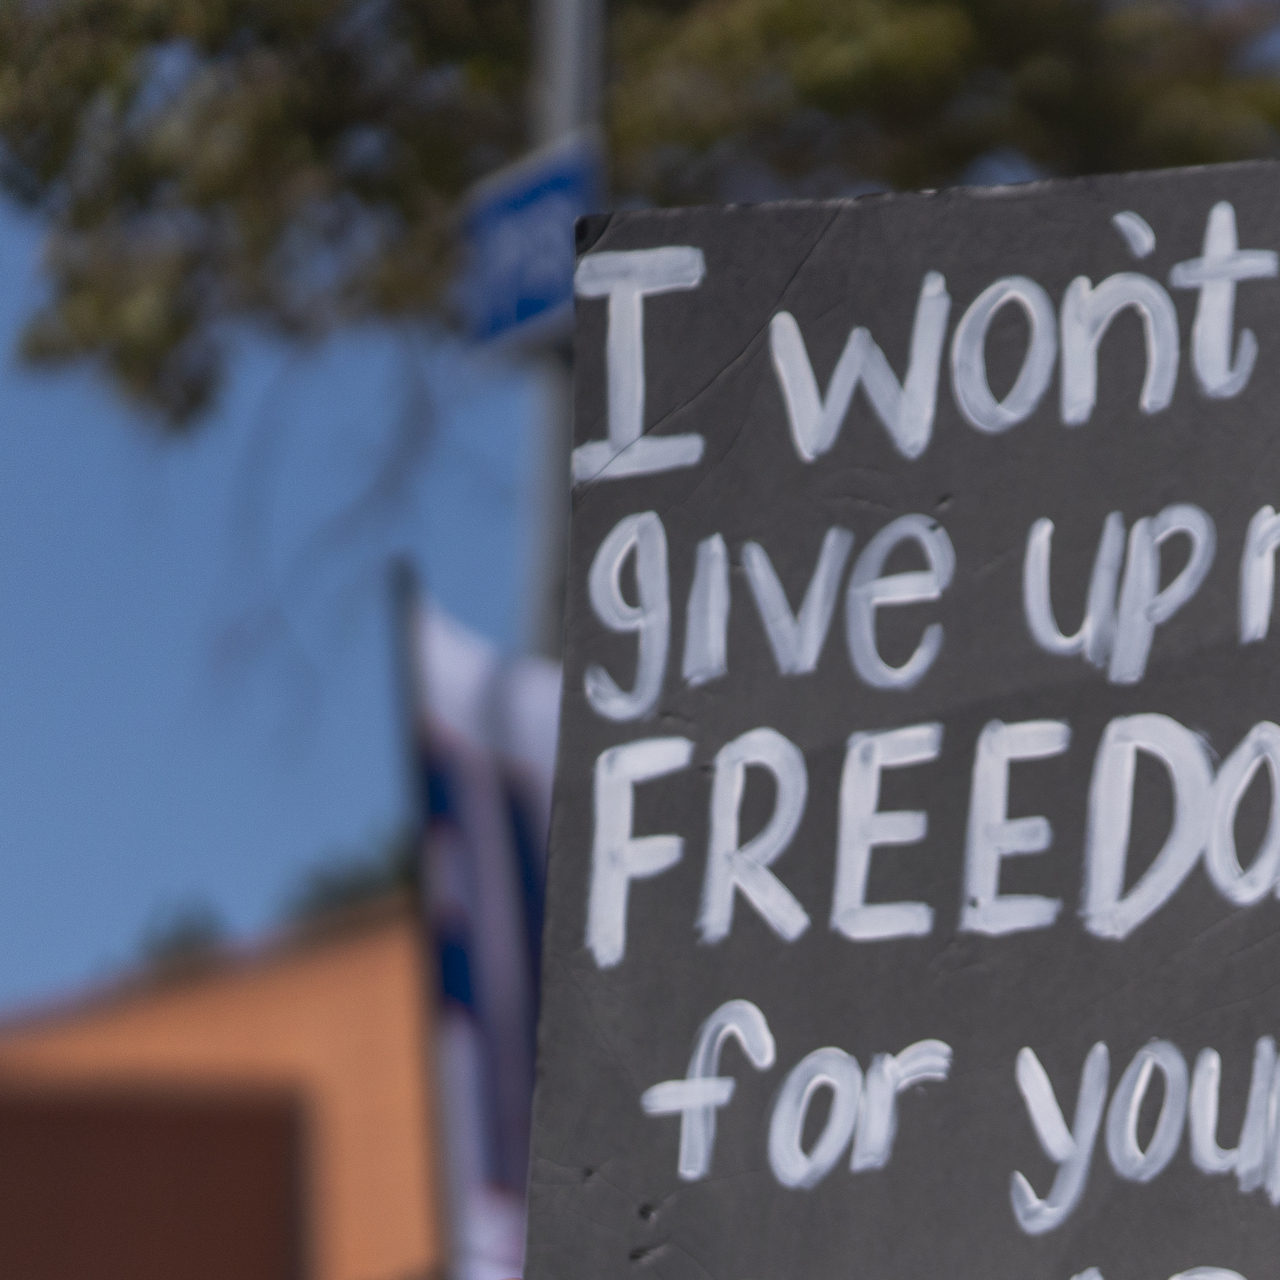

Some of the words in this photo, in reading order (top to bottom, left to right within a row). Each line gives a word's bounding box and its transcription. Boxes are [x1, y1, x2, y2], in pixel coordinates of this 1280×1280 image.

[575, 247, 706, 480] I
[771, 202, 1279, 459] won't
[586, 511, 955, 719] give
[1024, 503, 1216, 682] up
[642, 1000, 952, 1189] for
